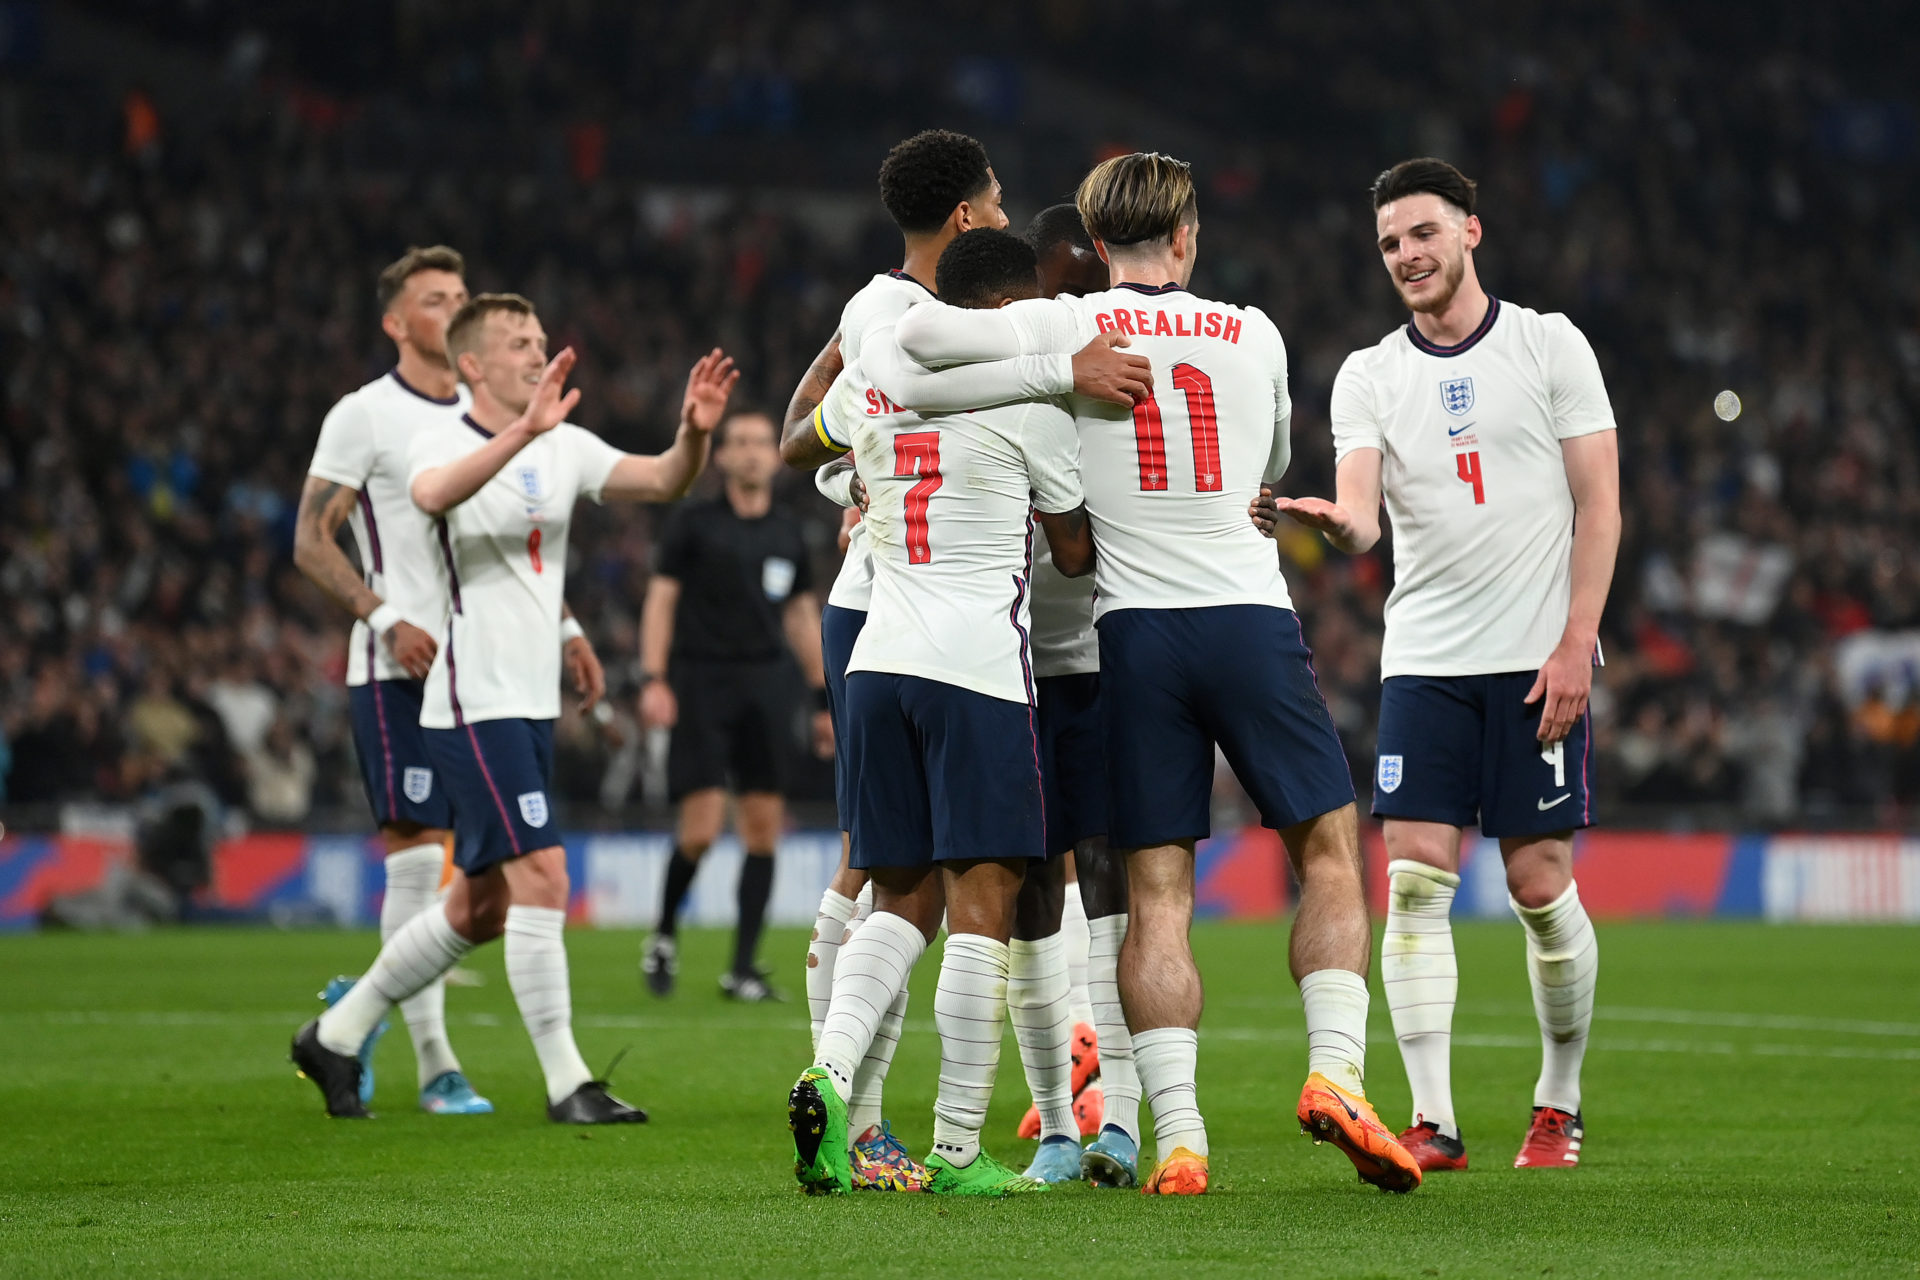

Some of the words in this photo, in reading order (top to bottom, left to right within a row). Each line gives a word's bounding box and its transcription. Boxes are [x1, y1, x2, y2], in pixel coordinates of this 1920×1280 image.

[1095, 308, 1242, 344] GREALISH
[1131, 362, 1222, 492] 11
[894, 431, 943, 564] 7
[1456, 451, 1485, 505] 4
[1541, 740, 1565, 787] 4
